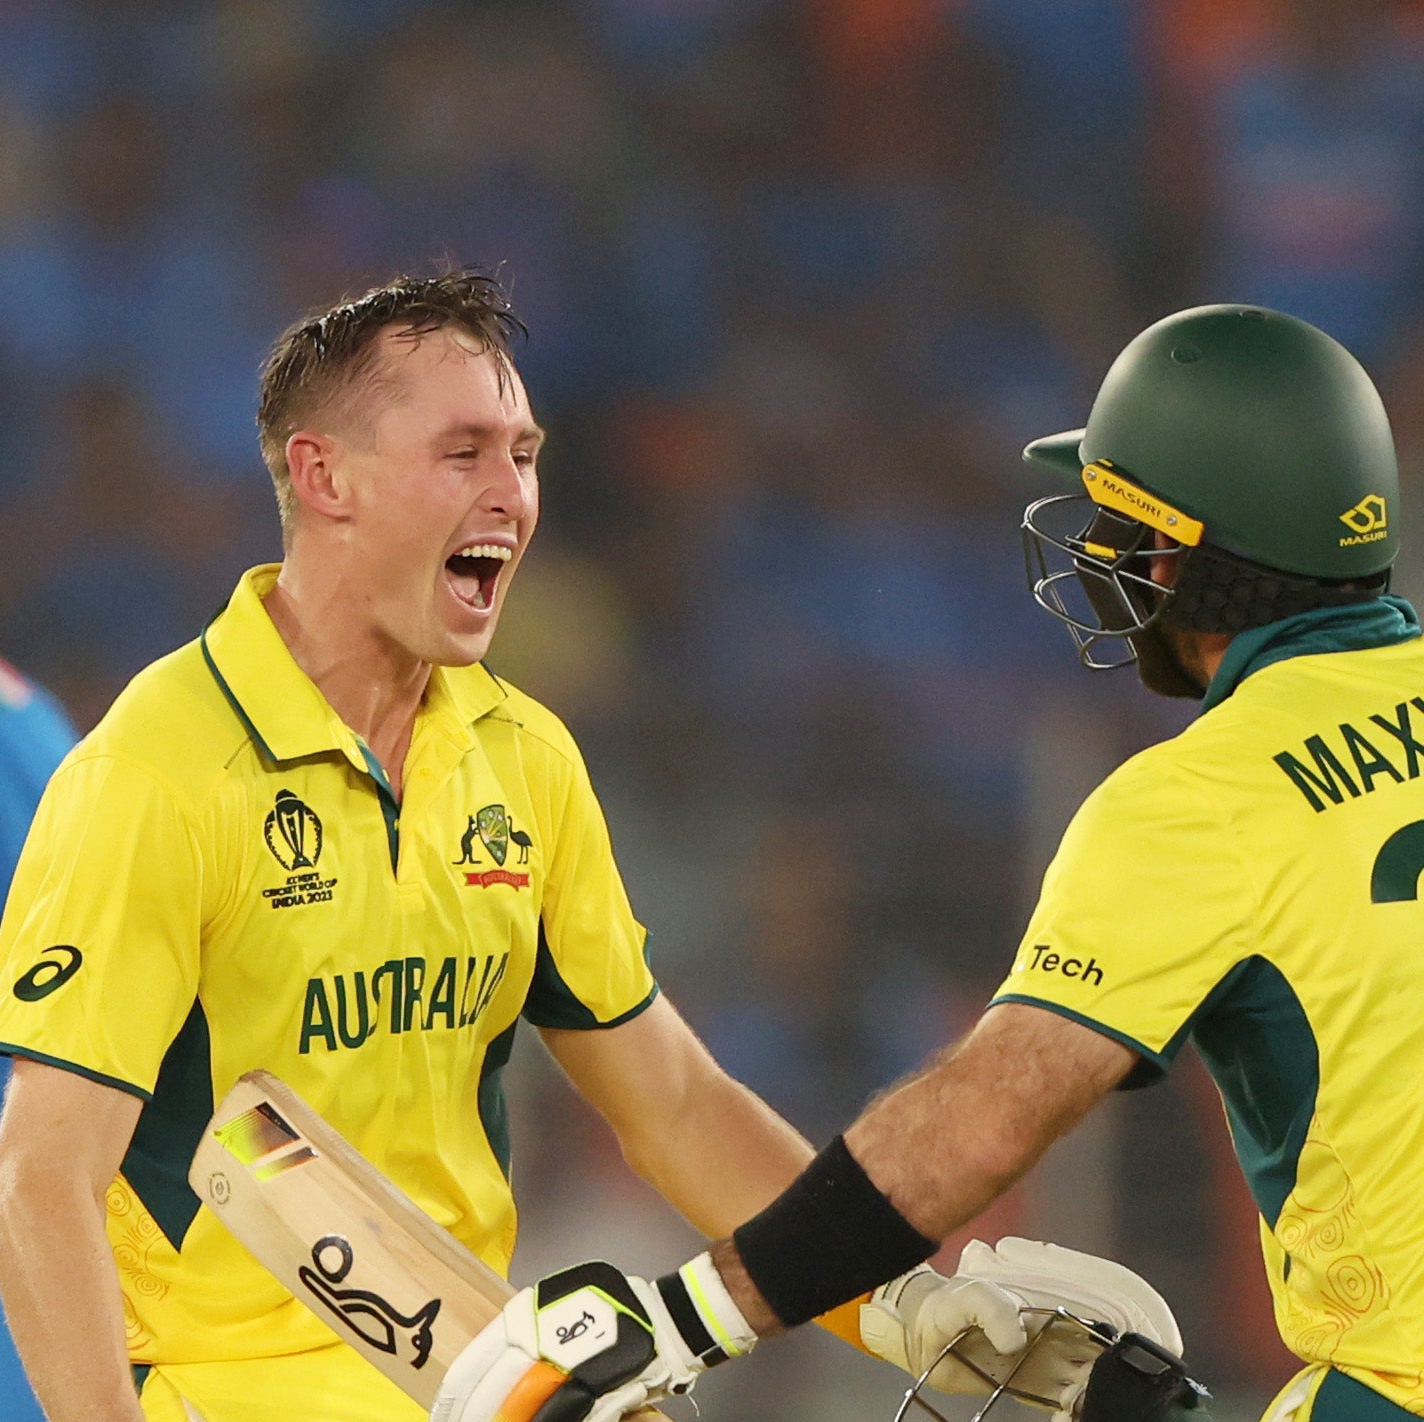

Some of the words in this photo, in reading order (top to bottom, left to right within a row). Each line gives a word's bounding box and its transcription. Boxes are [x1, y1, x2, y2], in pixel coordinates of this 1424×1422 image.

[1101, 478, 1162, 519] MASURI
[1339, 529, 1388, 547] MASURI
[272, 895, 306, 909] INDIA
[307, 890, 333, 904] 2023
[1029, 944, 1104, 987] Tech
[298, 951, 509, 1055] AUSTRALIA
